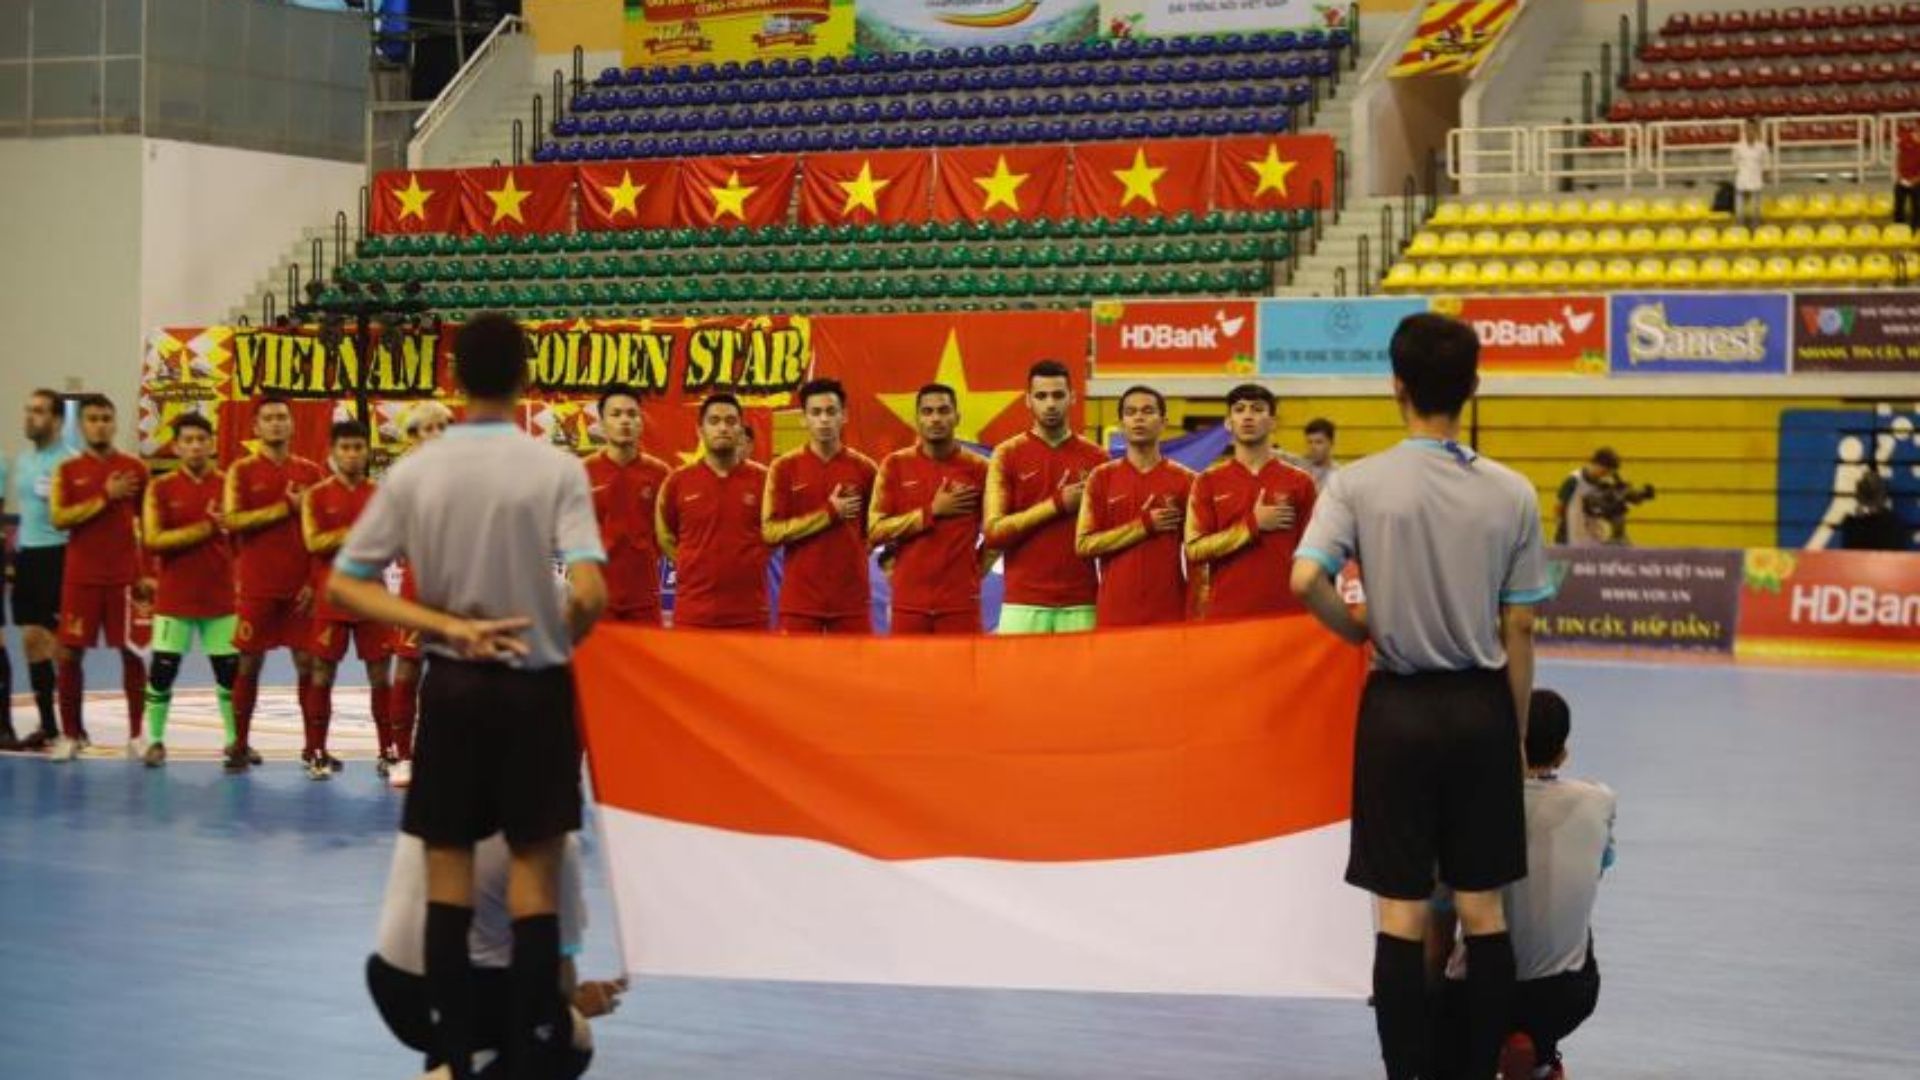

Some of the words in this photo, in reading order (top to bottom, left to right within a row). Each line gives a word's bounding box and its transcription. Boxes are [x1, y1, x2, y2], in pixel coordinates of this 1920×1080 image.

[1120, 324, 1218, 349] HDBank
[1472, 319, 1566, 346] DBank
[1628, 303, 1767, 364] Sanest
[235, 332, 438, 392] VIETNAM
[686, 329, 802, 387] STAR
[1791, 584, 1920, 626] HDBan
[1556, 616, 1585, 634] TIN
